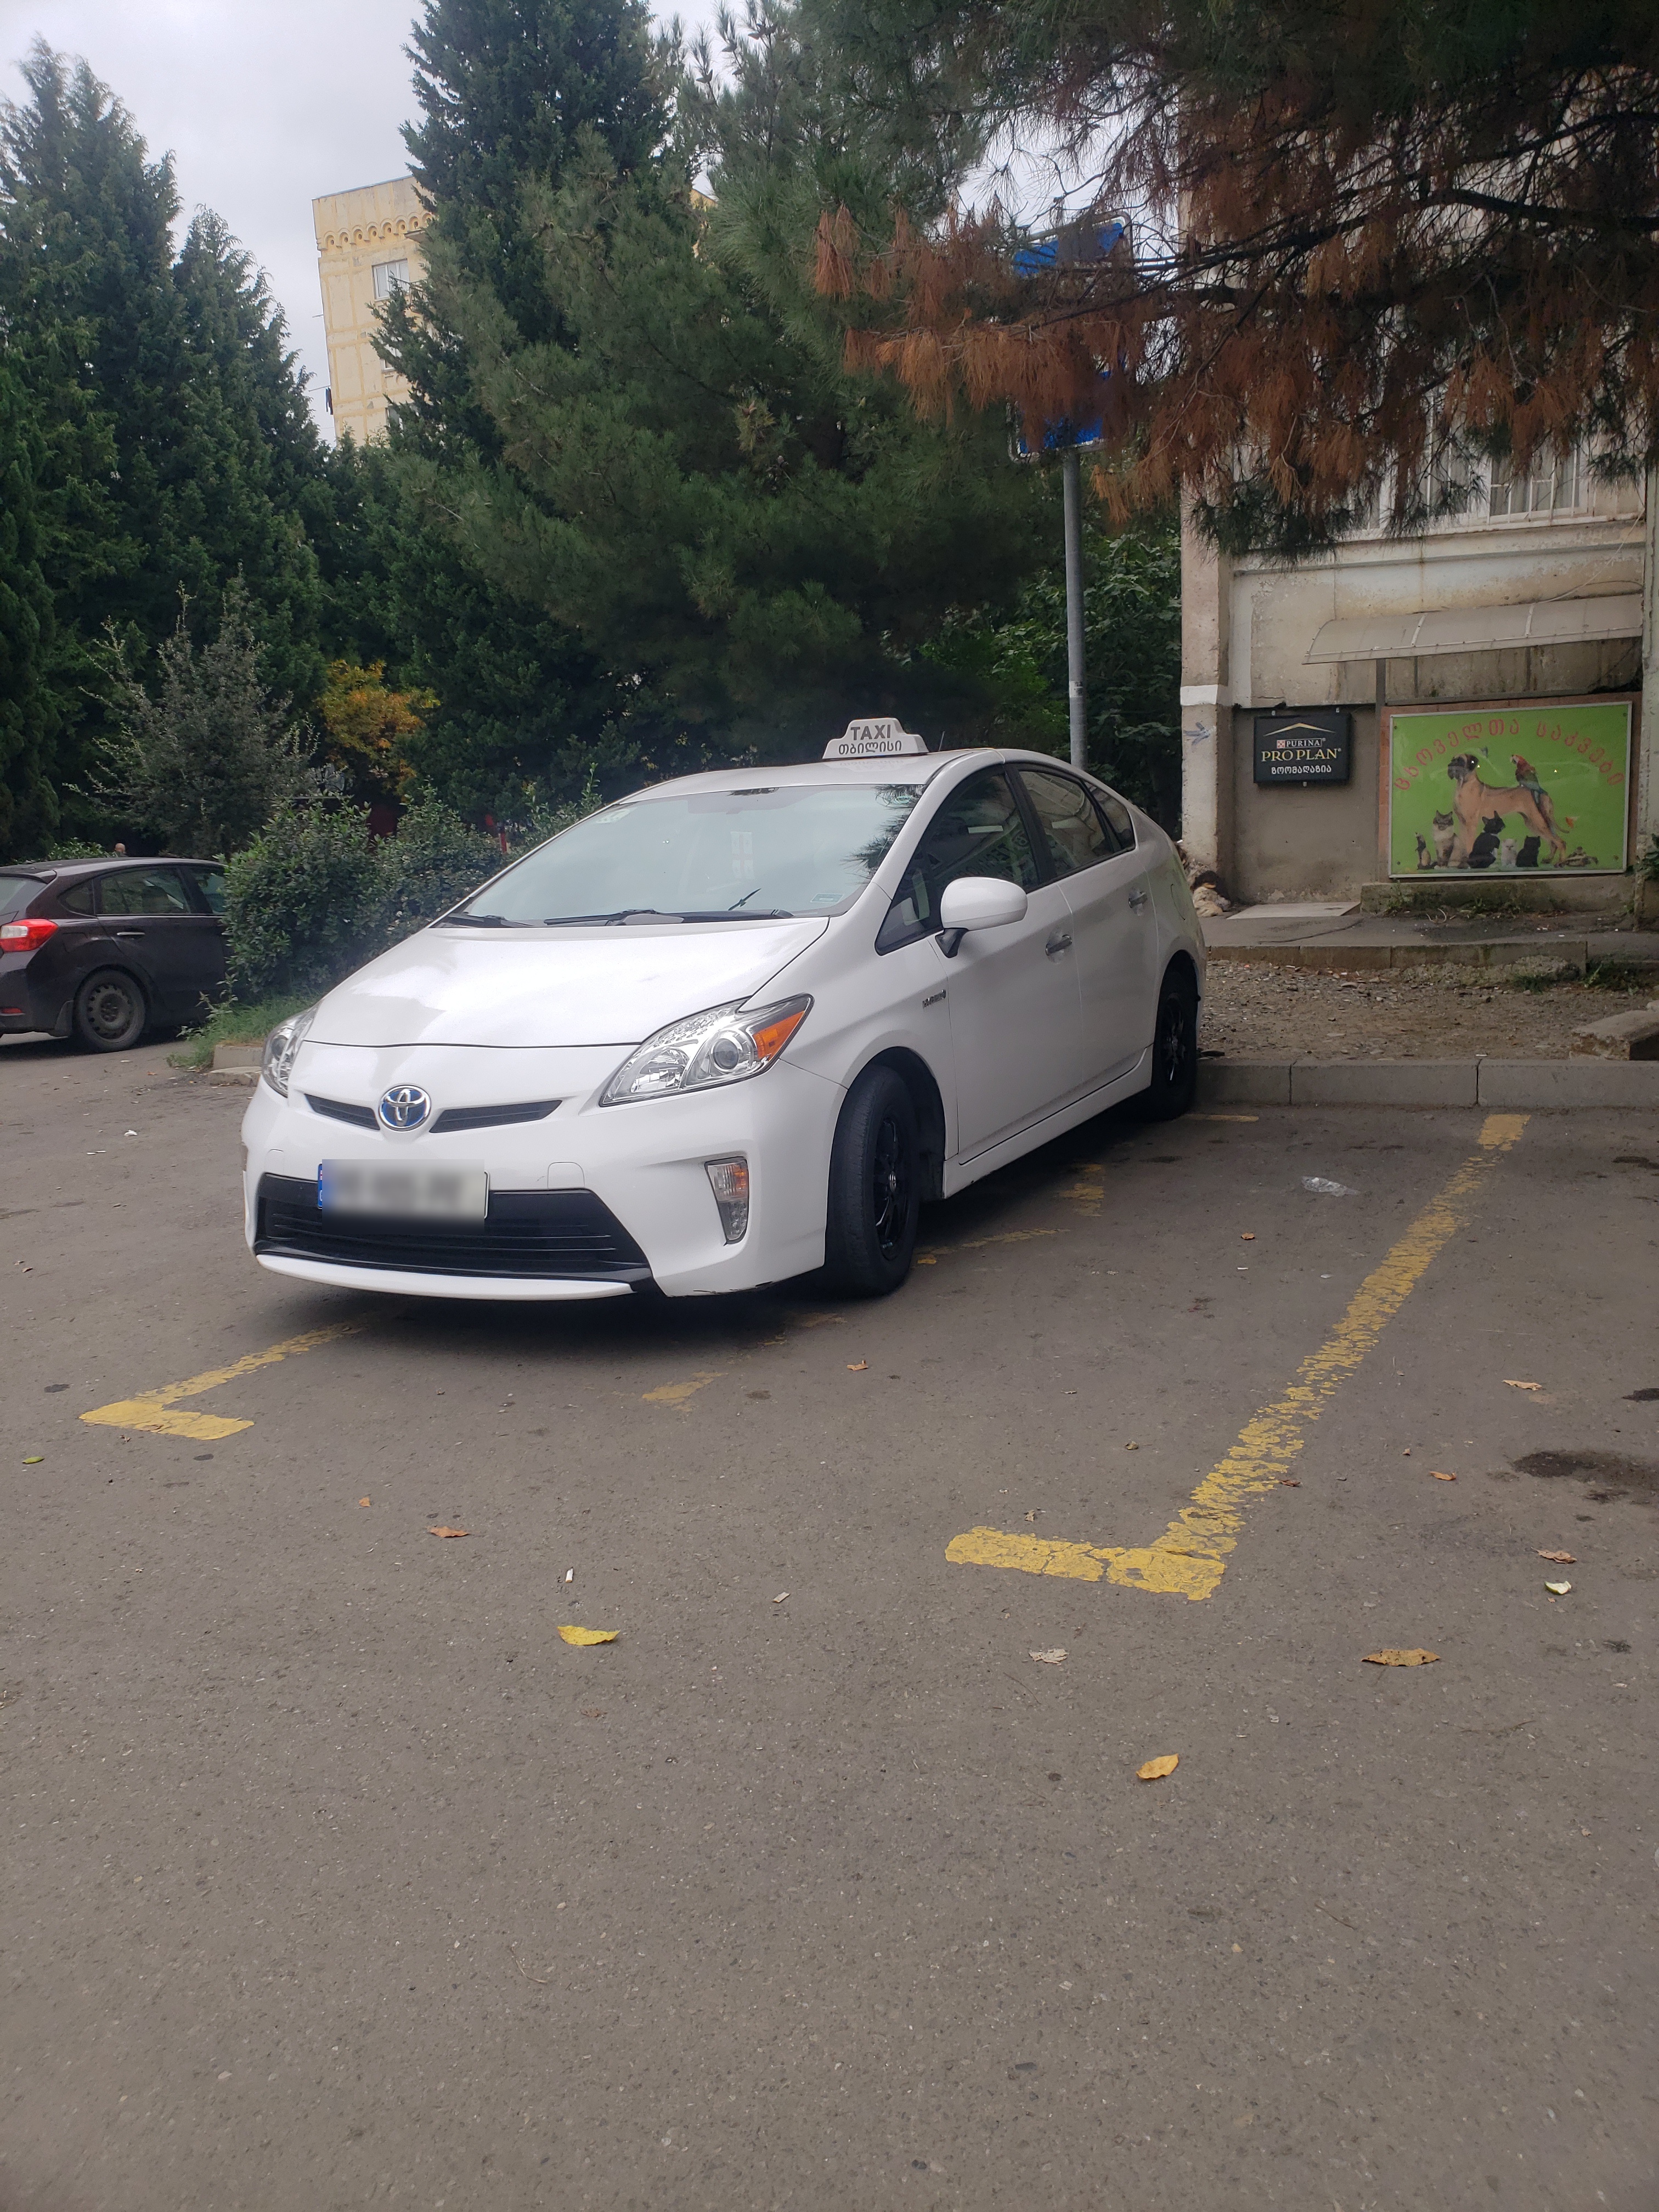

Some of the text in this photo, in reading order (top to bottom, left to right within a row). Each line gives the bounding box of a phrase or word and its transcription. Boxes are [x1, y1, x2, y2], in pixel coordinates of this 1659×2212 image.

[850, 724, 891, 741] TAXI
[838, 740, 902, 755] თბილისი
[1262, 748, 1337, 761] PRO PLAN
[1394, 719, 1520, 791] ცხოველთა
[1272, 765, 1331, 775] ზოომაღაზია
